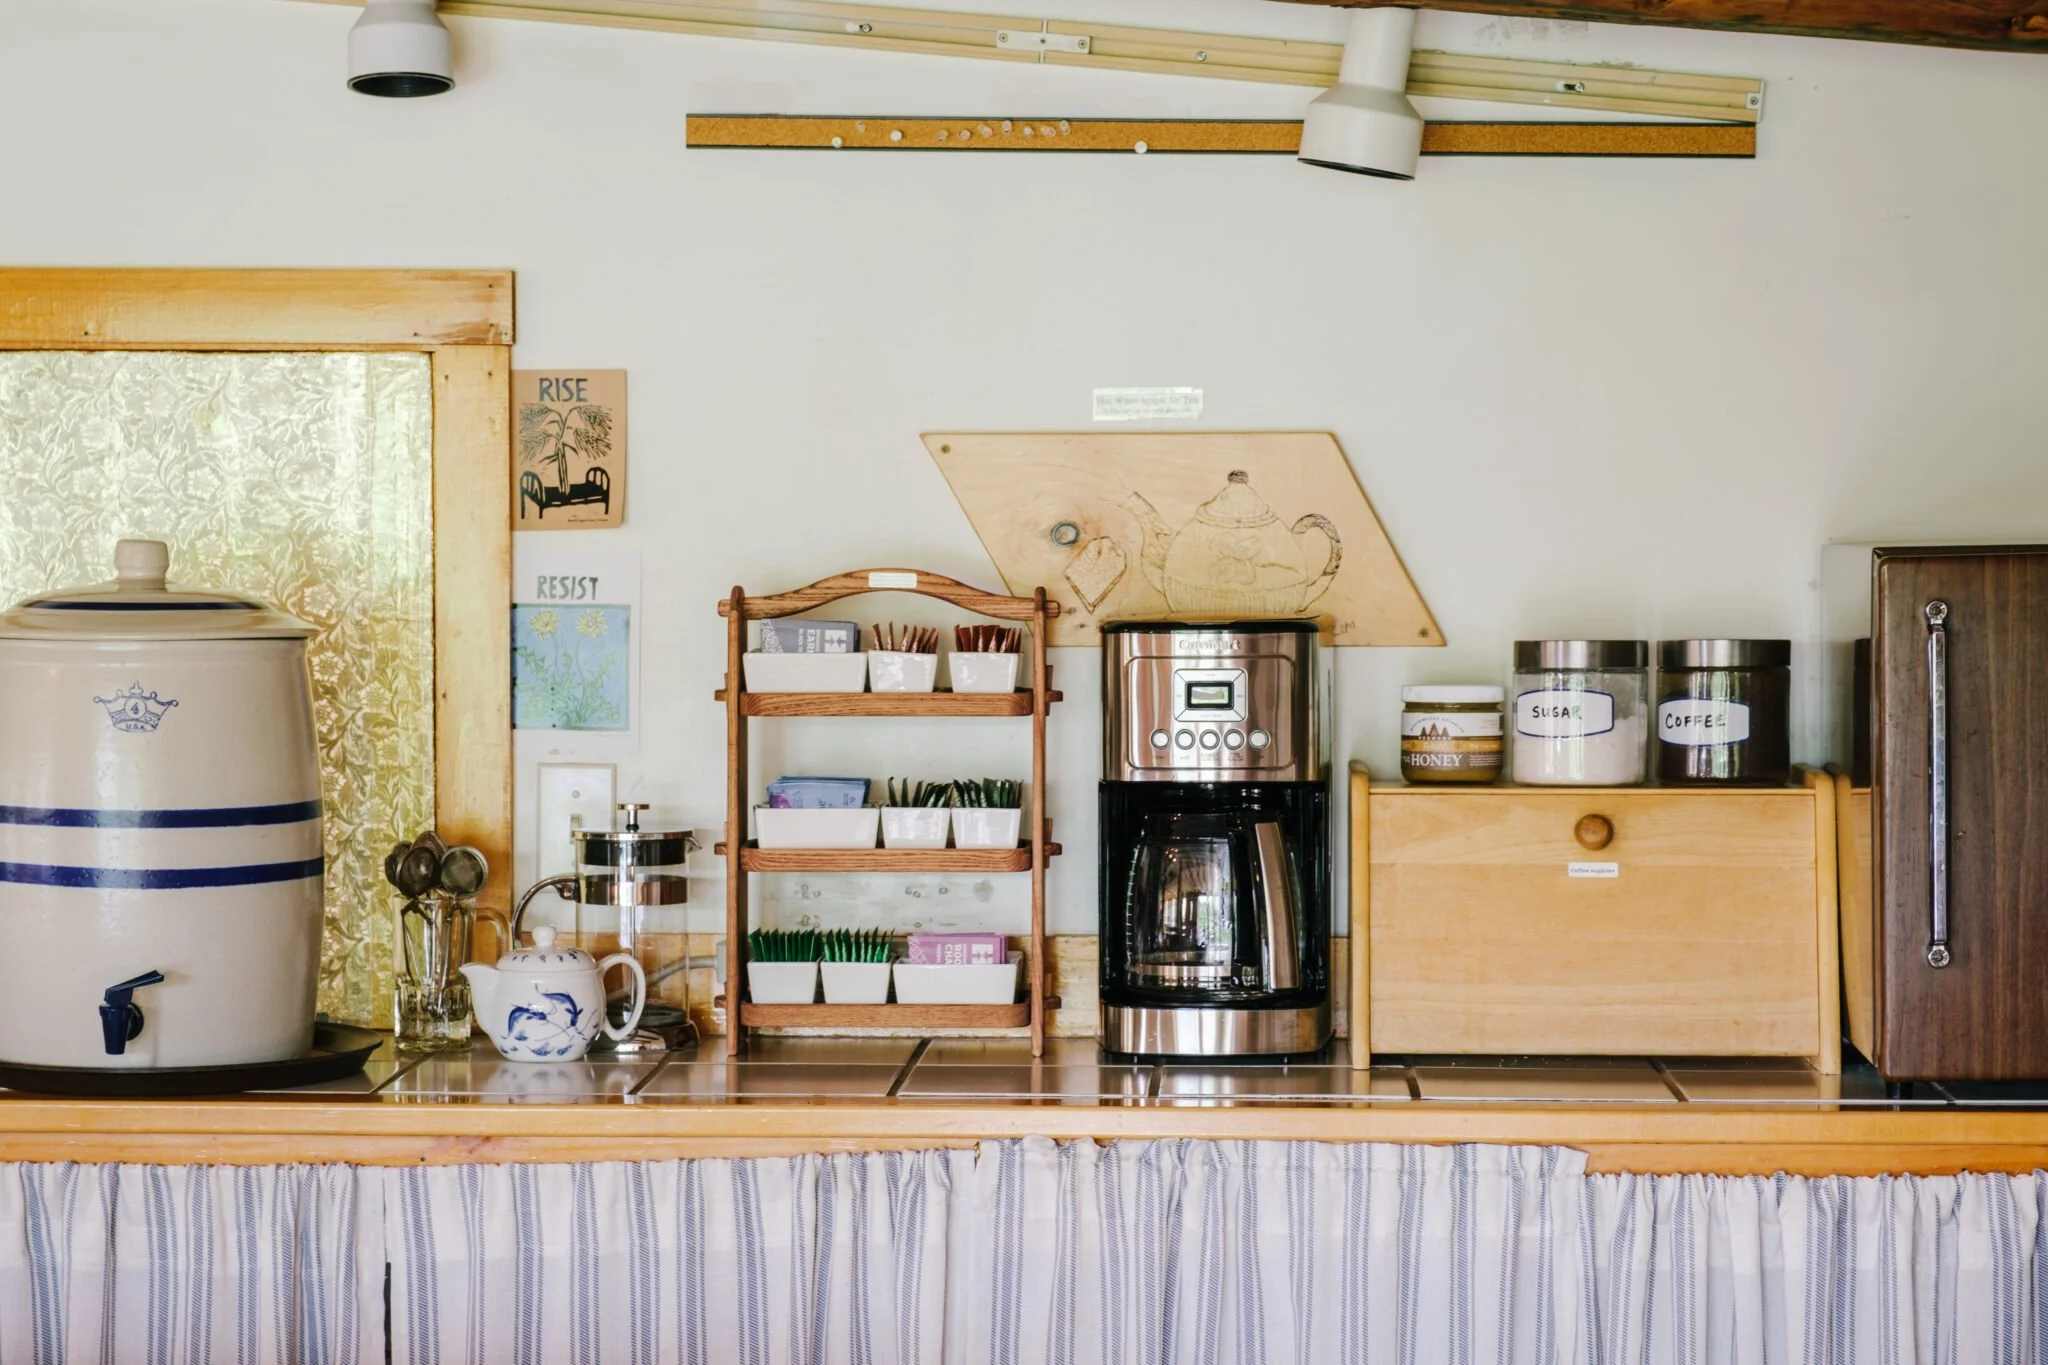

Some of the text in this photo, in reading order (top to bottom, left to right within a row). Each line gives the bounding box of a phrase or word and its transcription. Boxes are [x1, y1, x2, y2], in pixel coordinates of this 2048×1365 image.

[539, 377, 588, 402] RISE
[537, 575, 599, 600] RESIST
[1532, 705, 1582, 720] SUGAR
[1665, 713, 1726, 729] COFFEE
[1411, 753, 1463, 767] HONEY
